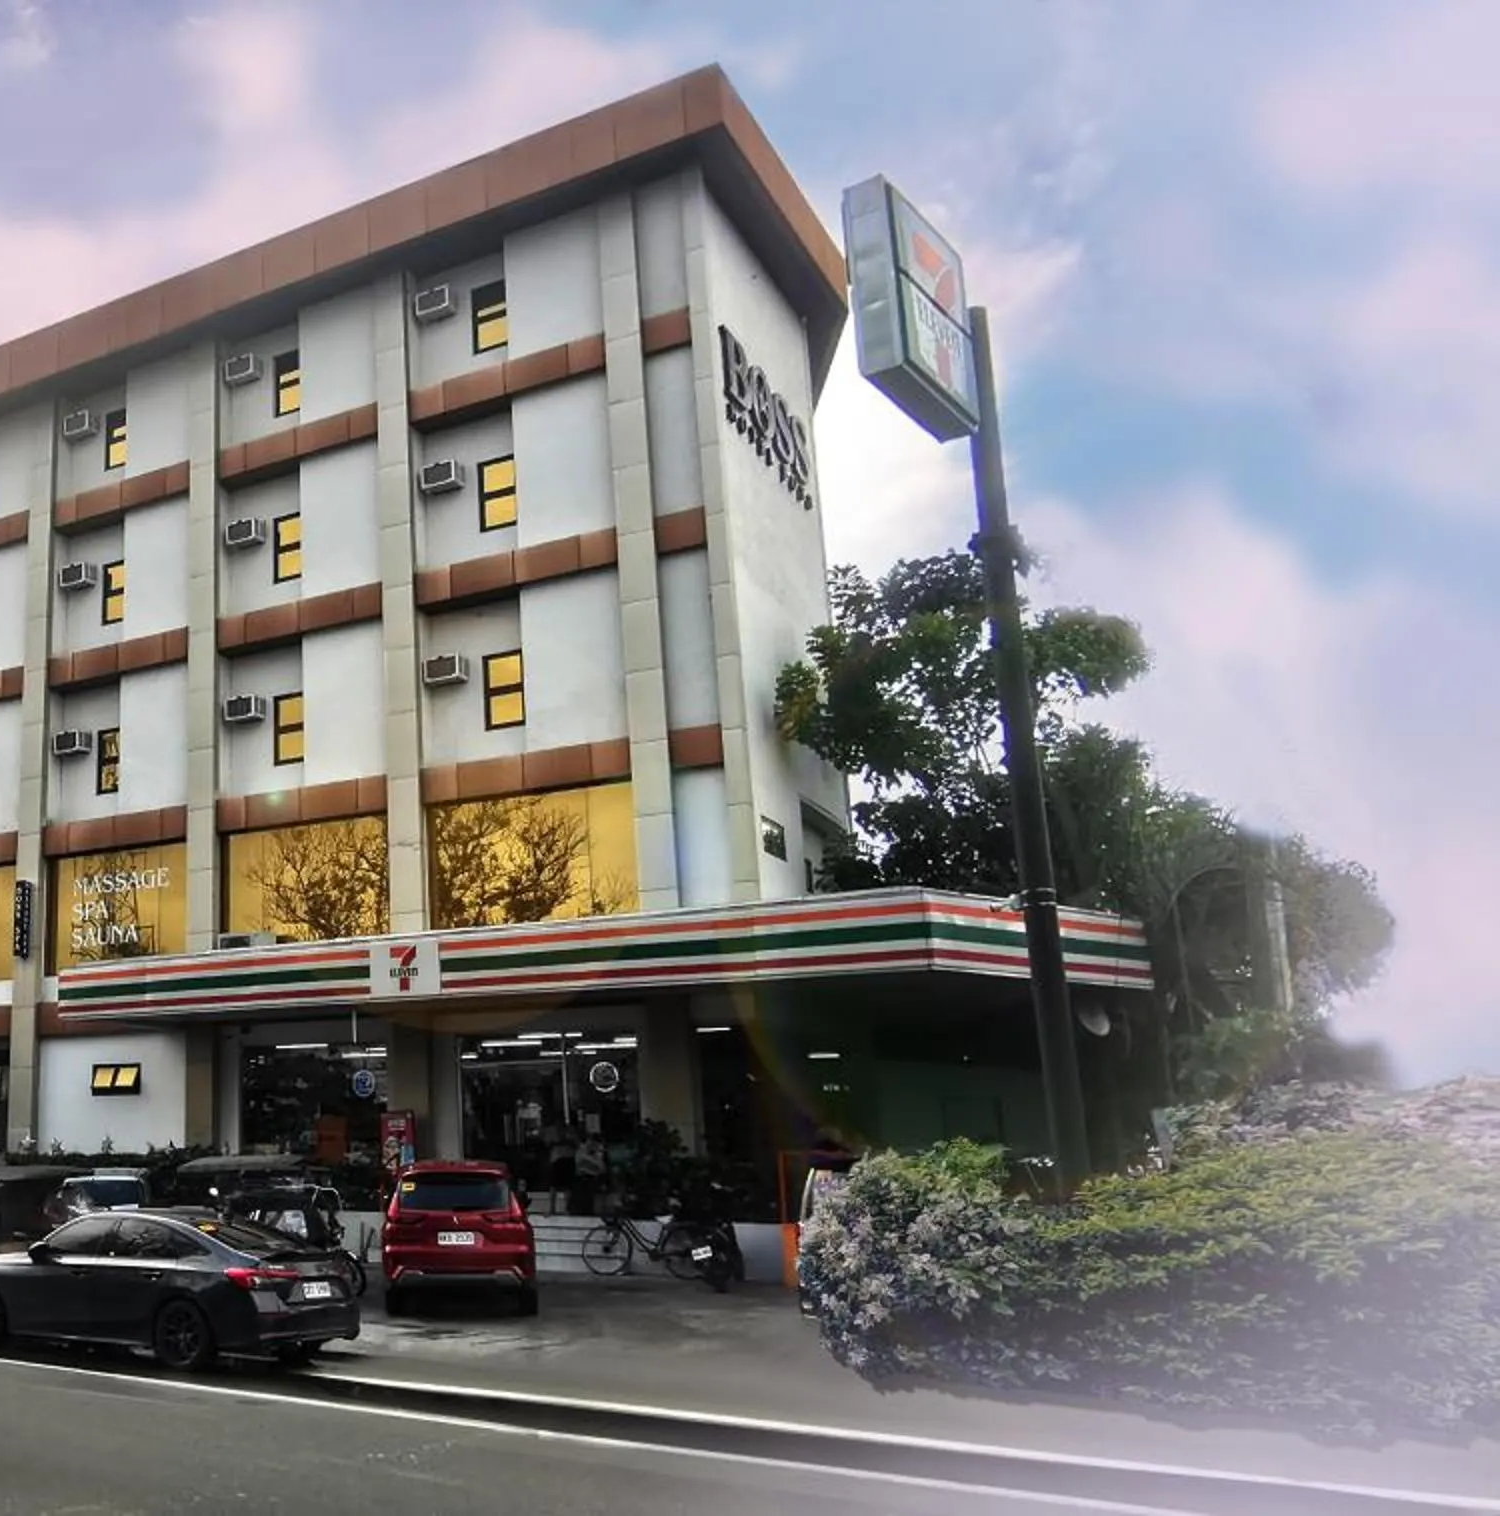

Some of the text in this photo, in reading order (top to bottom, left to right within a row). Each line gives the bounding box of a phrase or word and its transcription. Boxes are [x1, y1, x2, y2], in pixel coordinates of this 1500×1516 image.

[718, 324, 810, 487] BOSS
[73, 867, 170, 896] MASSAGE
[71, 899, 109, 921] SPA
[71, 923, 139, 949] SAUNA
[389, 945, 417, 992] 7
